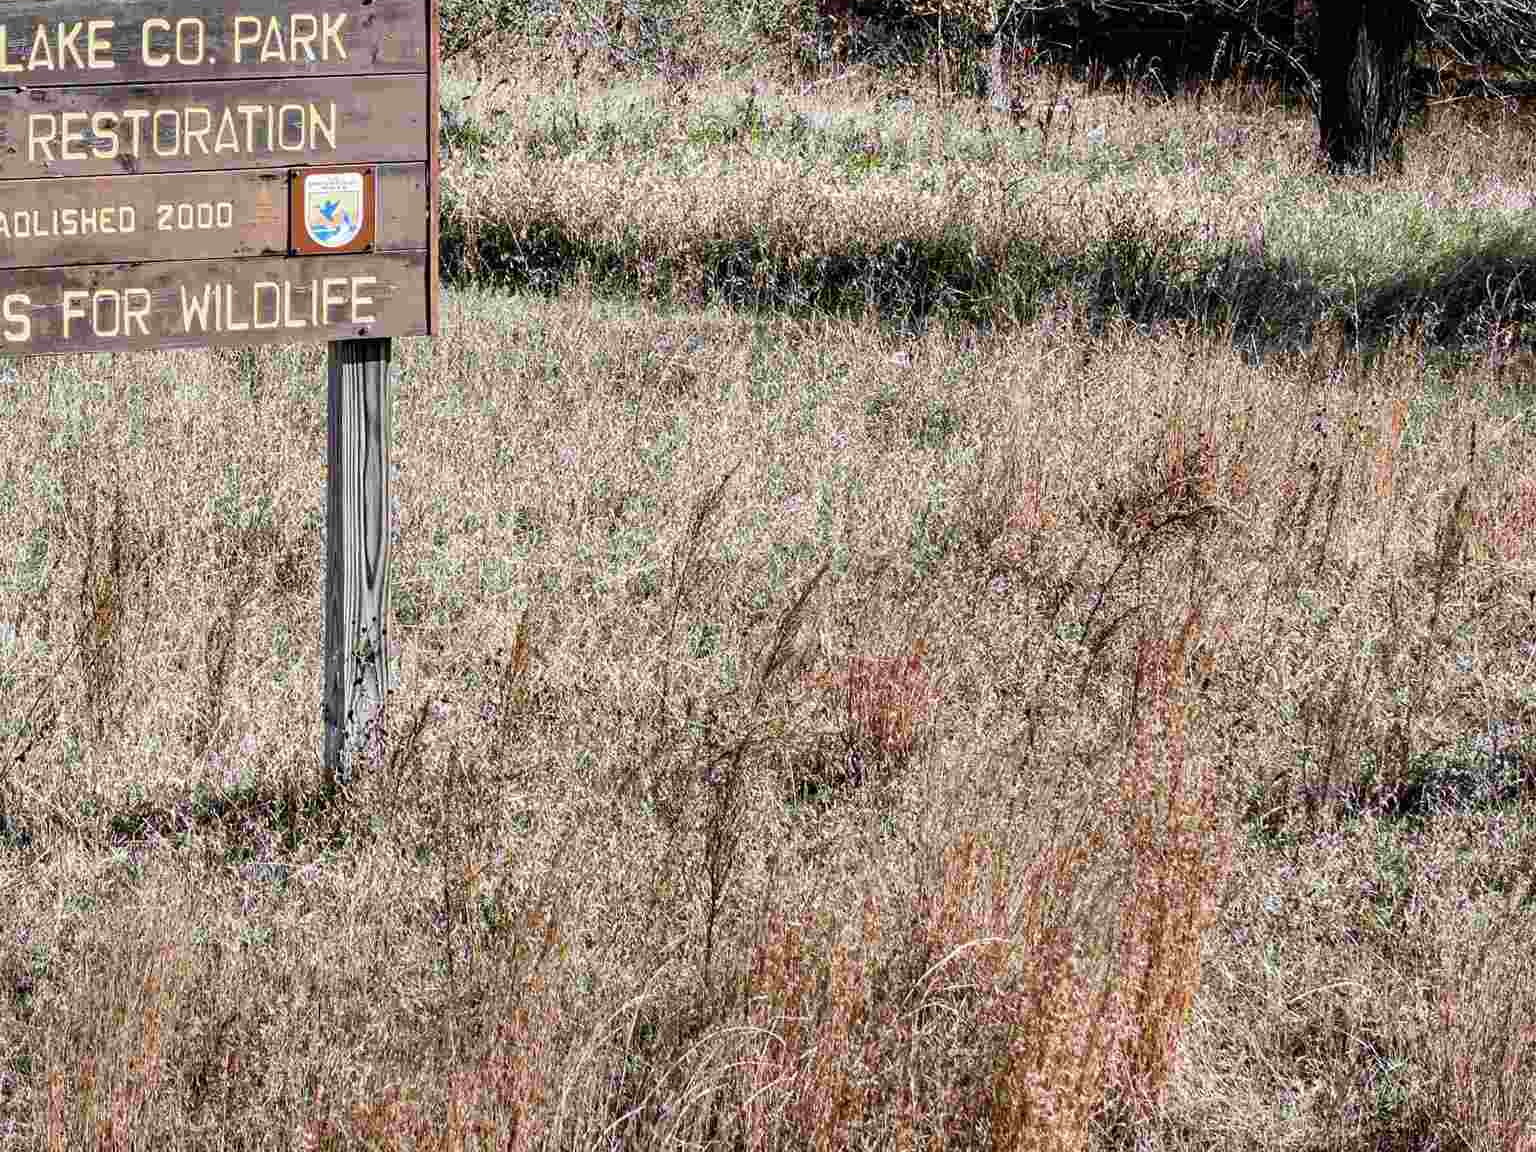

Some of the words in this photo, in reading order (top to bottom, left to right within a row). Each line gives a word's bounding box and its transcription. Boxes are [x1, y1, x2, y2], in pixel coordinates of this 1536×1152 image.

[142, 17, 216, 66] CO.
[234, 13, 349, 64] PARK
[28, 104, 337, 161] RESTORATION
[157, 202, 233, 231] 2000
[63, 287, 151, 338] FOR
[180, 276, 377, 332] WILDLIFE
